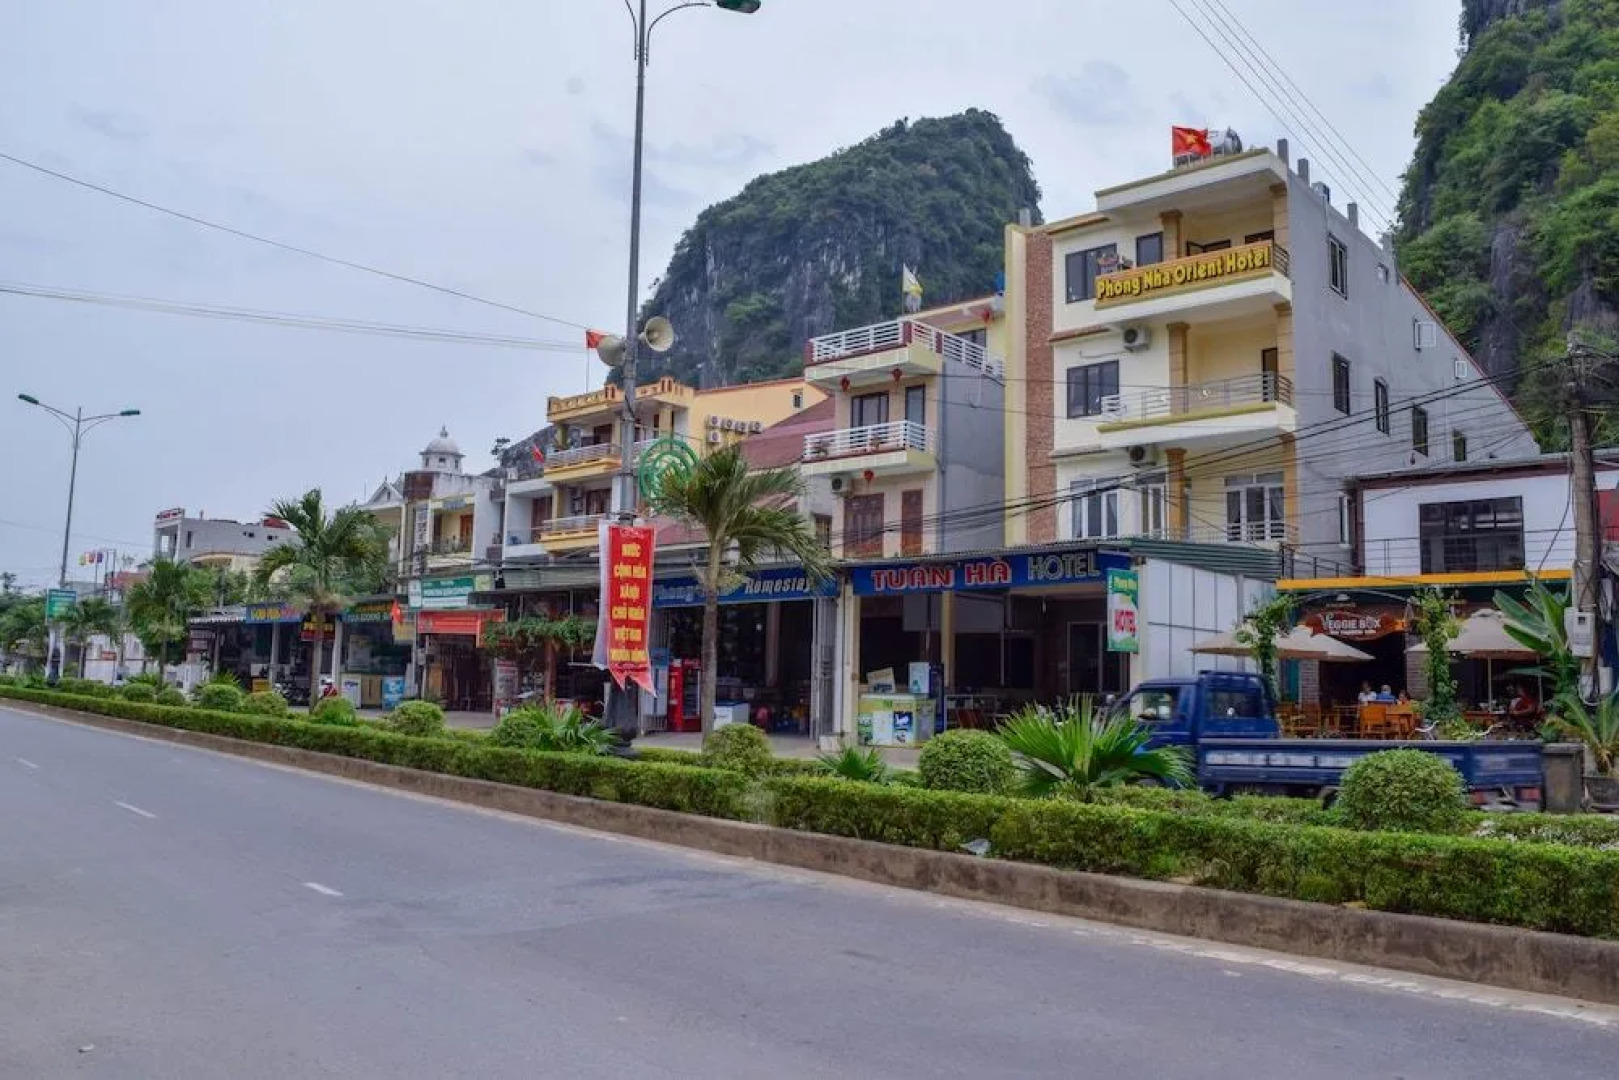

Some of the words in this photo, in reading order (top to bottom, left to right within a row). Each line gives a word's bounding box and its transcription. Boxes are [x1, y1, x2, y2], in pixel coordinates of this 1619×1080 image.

[1097, 277, 1141, 298] Phong
[1144, 269, 1172, 290] Nha
[1173, 257, 1223, 285] Orient
[1226, 246, 1270, 273] Hotel
[1027, 551, 1101, 580] HOTEL
[744, 577, 811, 595] Homestay
[1320, 611, 1358, 630] VEGGIE
[1360, 615, 1381, 630] BOX
